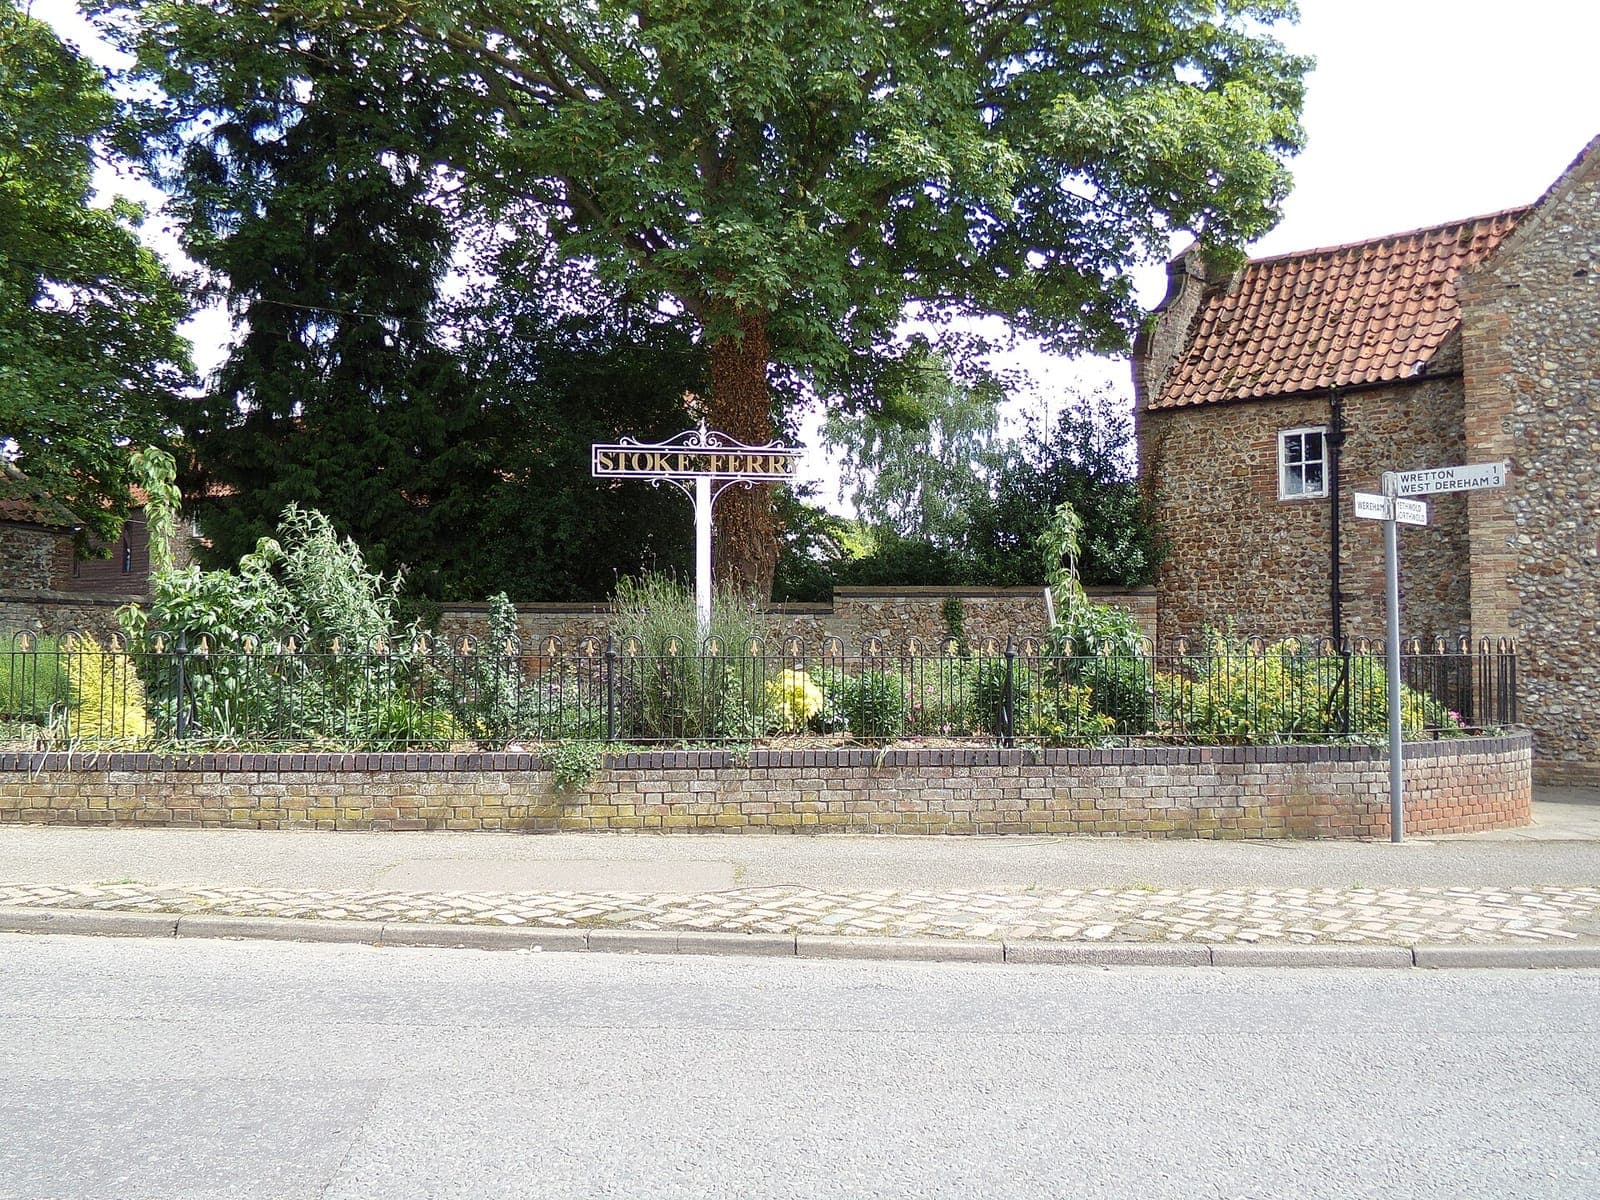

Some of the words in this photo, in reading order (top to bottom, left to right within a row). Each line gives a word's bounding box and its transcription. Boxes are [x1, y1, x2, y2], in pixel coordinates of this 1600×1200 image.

[599, 452, 694, 472] STOKE
[710, 454, 800, 474] FERRY
[1400, 470, 1454, 482] WRETTON
[1493, 465, 1497, 474] 1
[1400, 482, 1430, 493] WEST
[1435, 477, 1489, 490] DEREHAM
[1493, 476, 1500, 485] 3
[1357, 501, 1385, 512] WEREHAM
